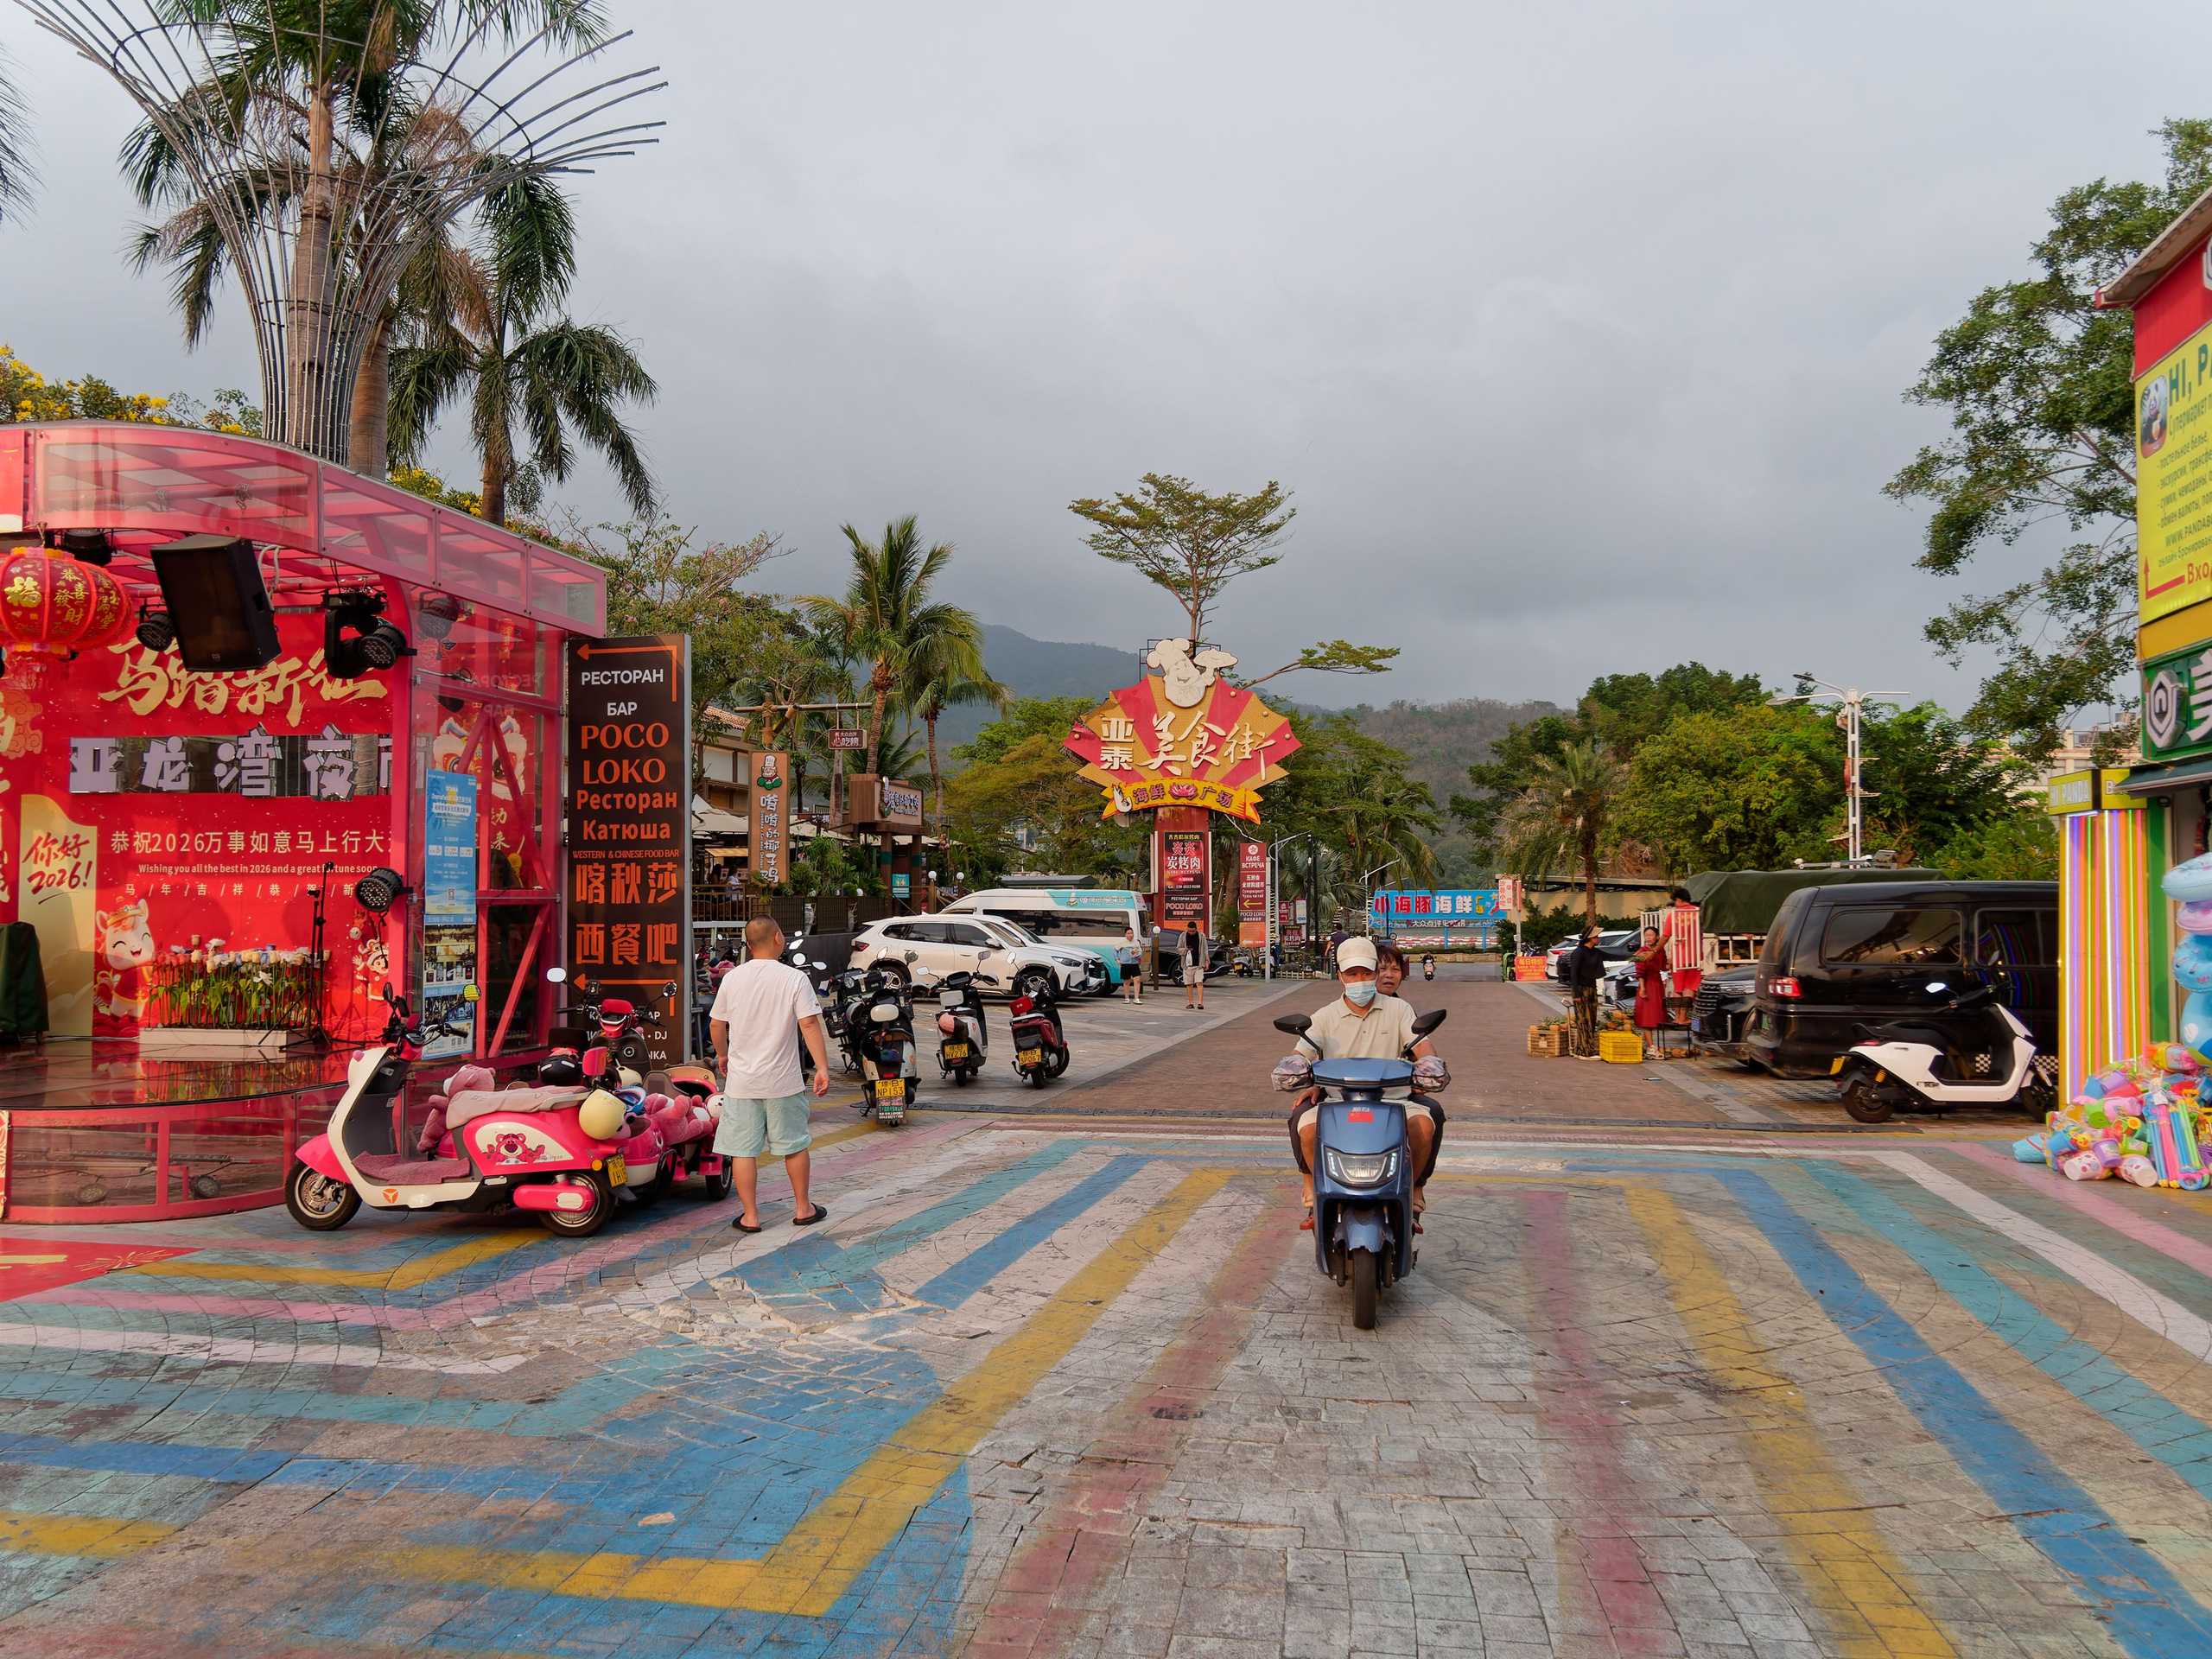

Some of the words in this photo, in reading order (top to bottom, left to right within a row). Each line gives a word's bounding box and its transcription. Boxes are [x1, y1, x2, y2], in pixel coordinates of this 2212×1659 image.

[2187, 562, 2212, 585] Вхо
[4, 576, 41, 607] 福
[581, 668, 664, 685] РЕСТОРАН
[607, 702, 638, 716] БАР
[581, 722, 670, 750] POCO
[1100, 717, 1135, 771] 亚泰
[1136, 710, 1276, 780] 美食街
[67, 722, 392, 802] 亚龙湾夜
[583, 758, 666, 785] LOKO
[576, 789, 677, 814] Ресторан
[1133, 784, 1166, 804] 海鲜
[1199, 786, 1234, 807] 广场
[2062, 779, 2089, 804] PANDA
[111, 830, 391, 854] 恭祝2026万事如意马上行大
[583, 819, 671, 841] Катюша
[22, 832, 90, 867] 你好
[572, 850, 606, 859] WESTERN
[608, 850, 613, 859] &
[614, 850, 644, 859] CHINESE
[645, 849, 664, 858] FOOD
[664, 849, 679, 858] BAR
[139, 864, 173, 874] Wishing
[175, 865, 190, 874] you
[192, 864, 203, 873] all
[204, 864, 219, 873] the
[219, 864, 239, 873] best
[240, 864, 249, 873] in
[250, 864, 271, 874] 2026
[272, 864, 289, 874] and
[297, 865, 321, 875] great
[1166, 856, 1201, 871] 炭烤肉
[27, 861, 93, 895] 2026!
[575, 862, 677, 904] 喀秋莎
[575, 923, 677, 964] 西餐吧
[654, 1031, 668, 1040] DJ
[945, 1049, 968, 1058] HV276
